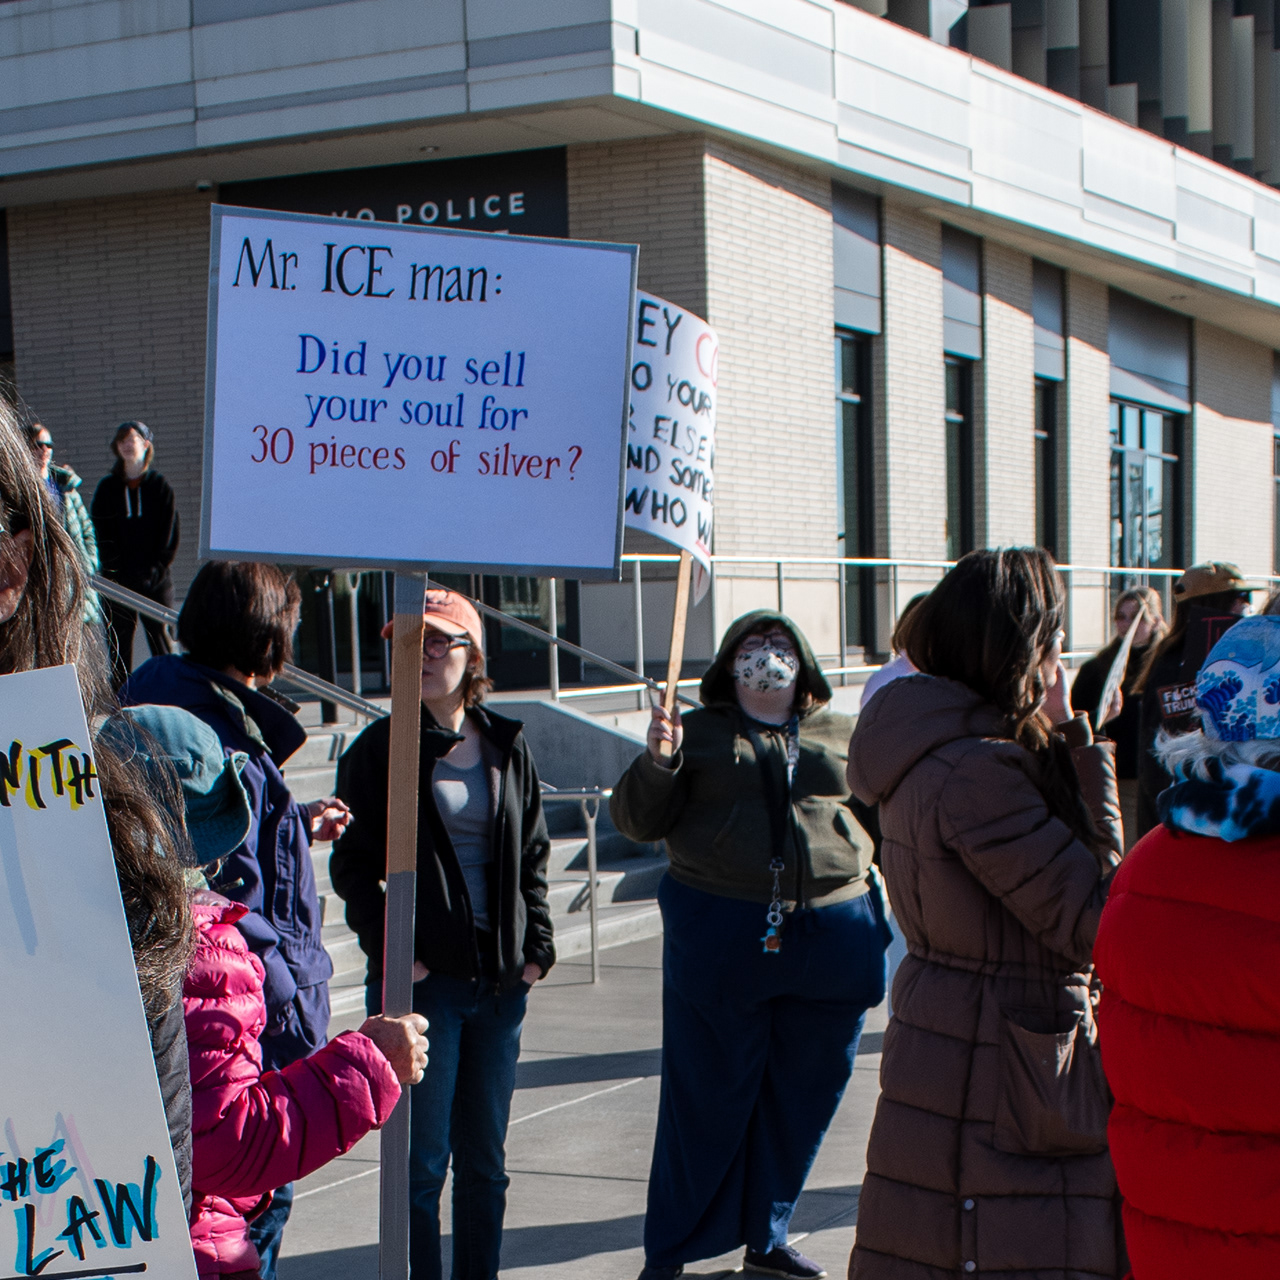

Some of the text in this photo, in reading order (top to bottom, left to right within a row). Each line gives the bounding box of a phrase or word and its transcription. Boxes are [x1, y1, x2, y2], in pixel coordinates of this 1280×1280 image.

[396, 192, 525, 224] POLICE
[231, 236, 503, 302] Mr. ICE man:
[296, 333, 526, 389] Did you sell
[305, 392, 529, 432] your soul for
[667, 372, 713, 422] YOUR
[251, 424, 584, 482] 30 pieces of silver?
[653, 414, 708, 462] ELSE
[15, 1154, 162, 1276] LAW
